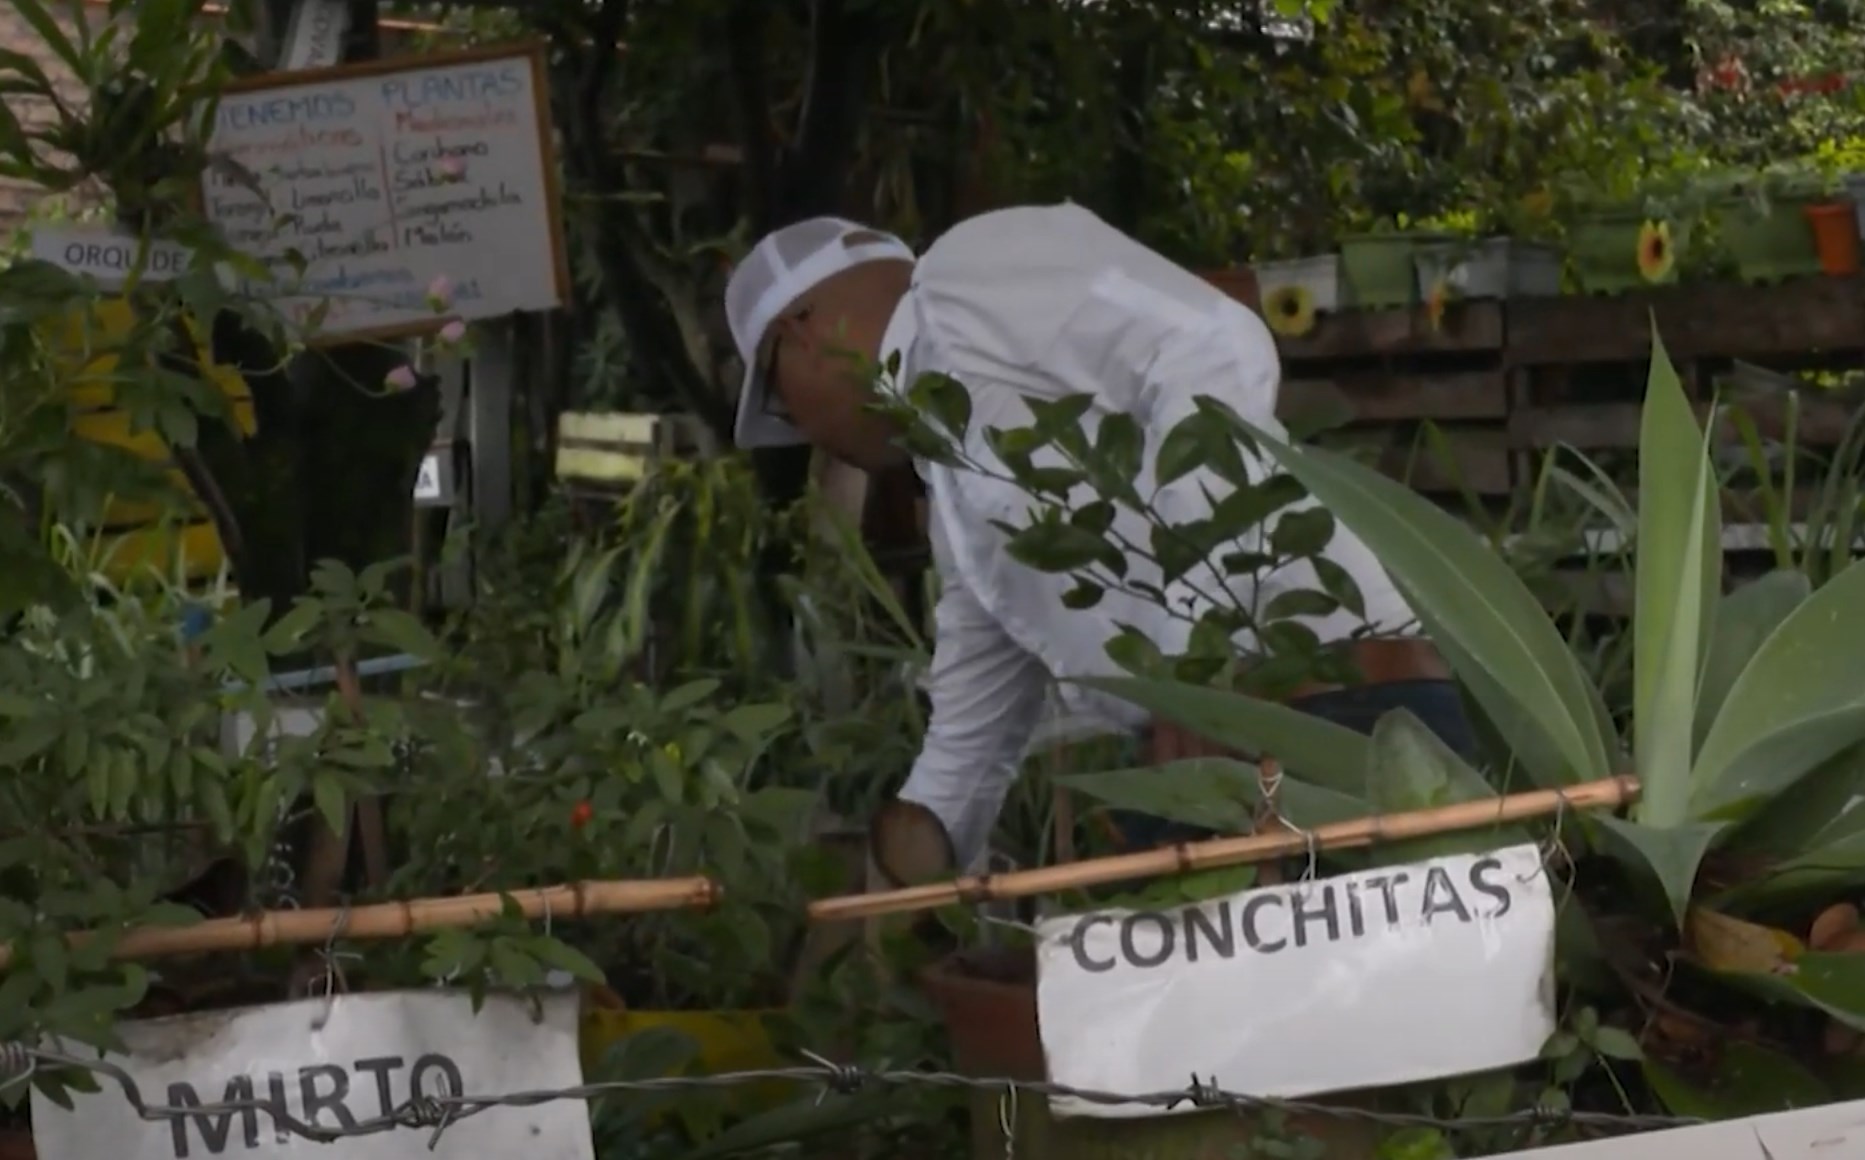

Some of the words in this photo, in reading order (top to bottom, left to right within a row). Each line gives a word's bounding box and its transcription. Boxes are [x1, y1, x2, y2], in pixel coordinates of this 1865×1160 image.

[381, 68, 522, 109] PLANTAS
[1070, 860, 1512, 973] CONCHITAS
[166, 1053, 463, 1159] MIRTO
